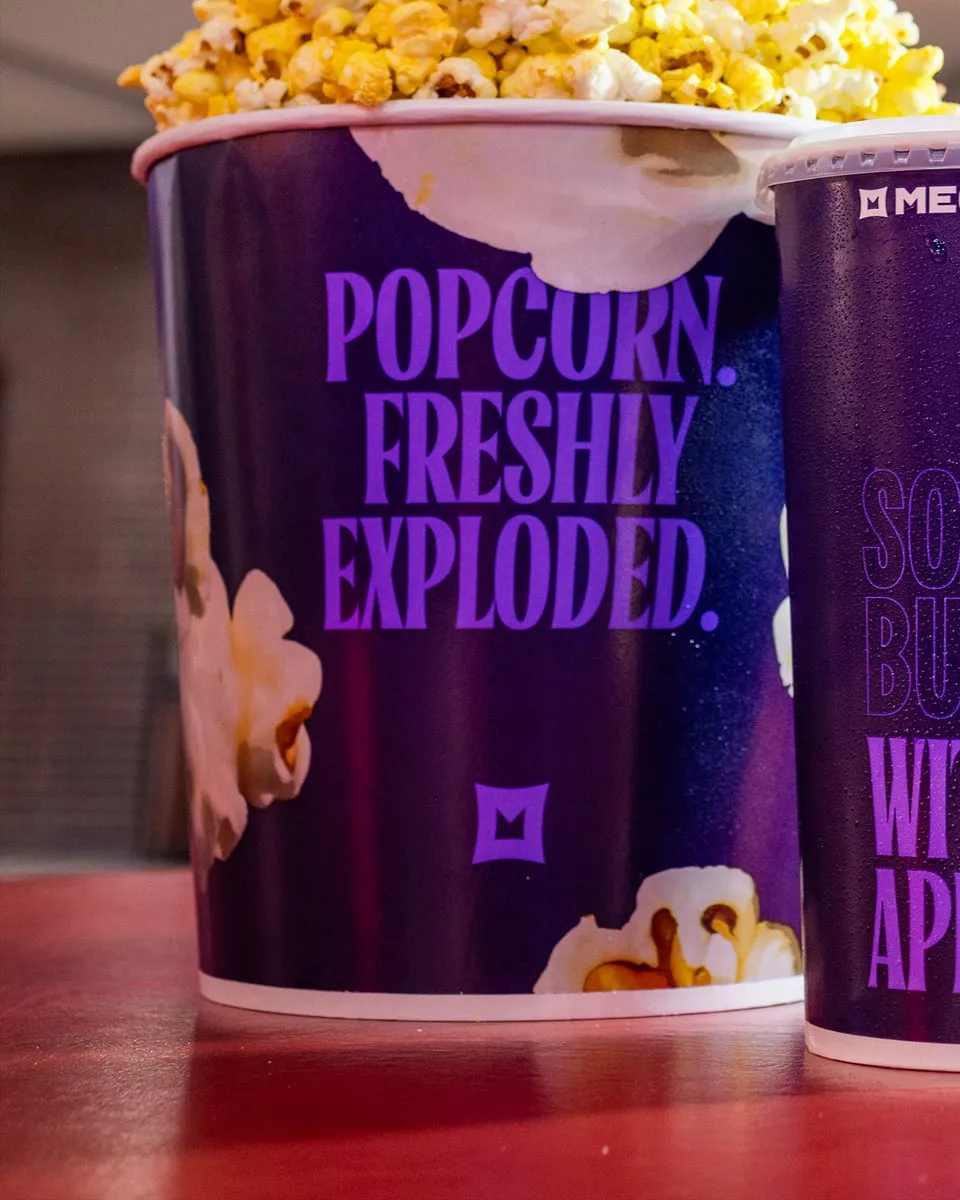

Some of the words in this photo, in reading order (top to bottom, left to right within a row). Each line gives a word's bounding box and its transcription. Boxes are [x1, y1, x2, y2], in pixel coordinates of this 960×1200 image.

[325, 267, 738, 388] POPCORN.
[364, 390, 699, 505] FRESHLY
[322, 514, 720, 631] EXPLODED.
